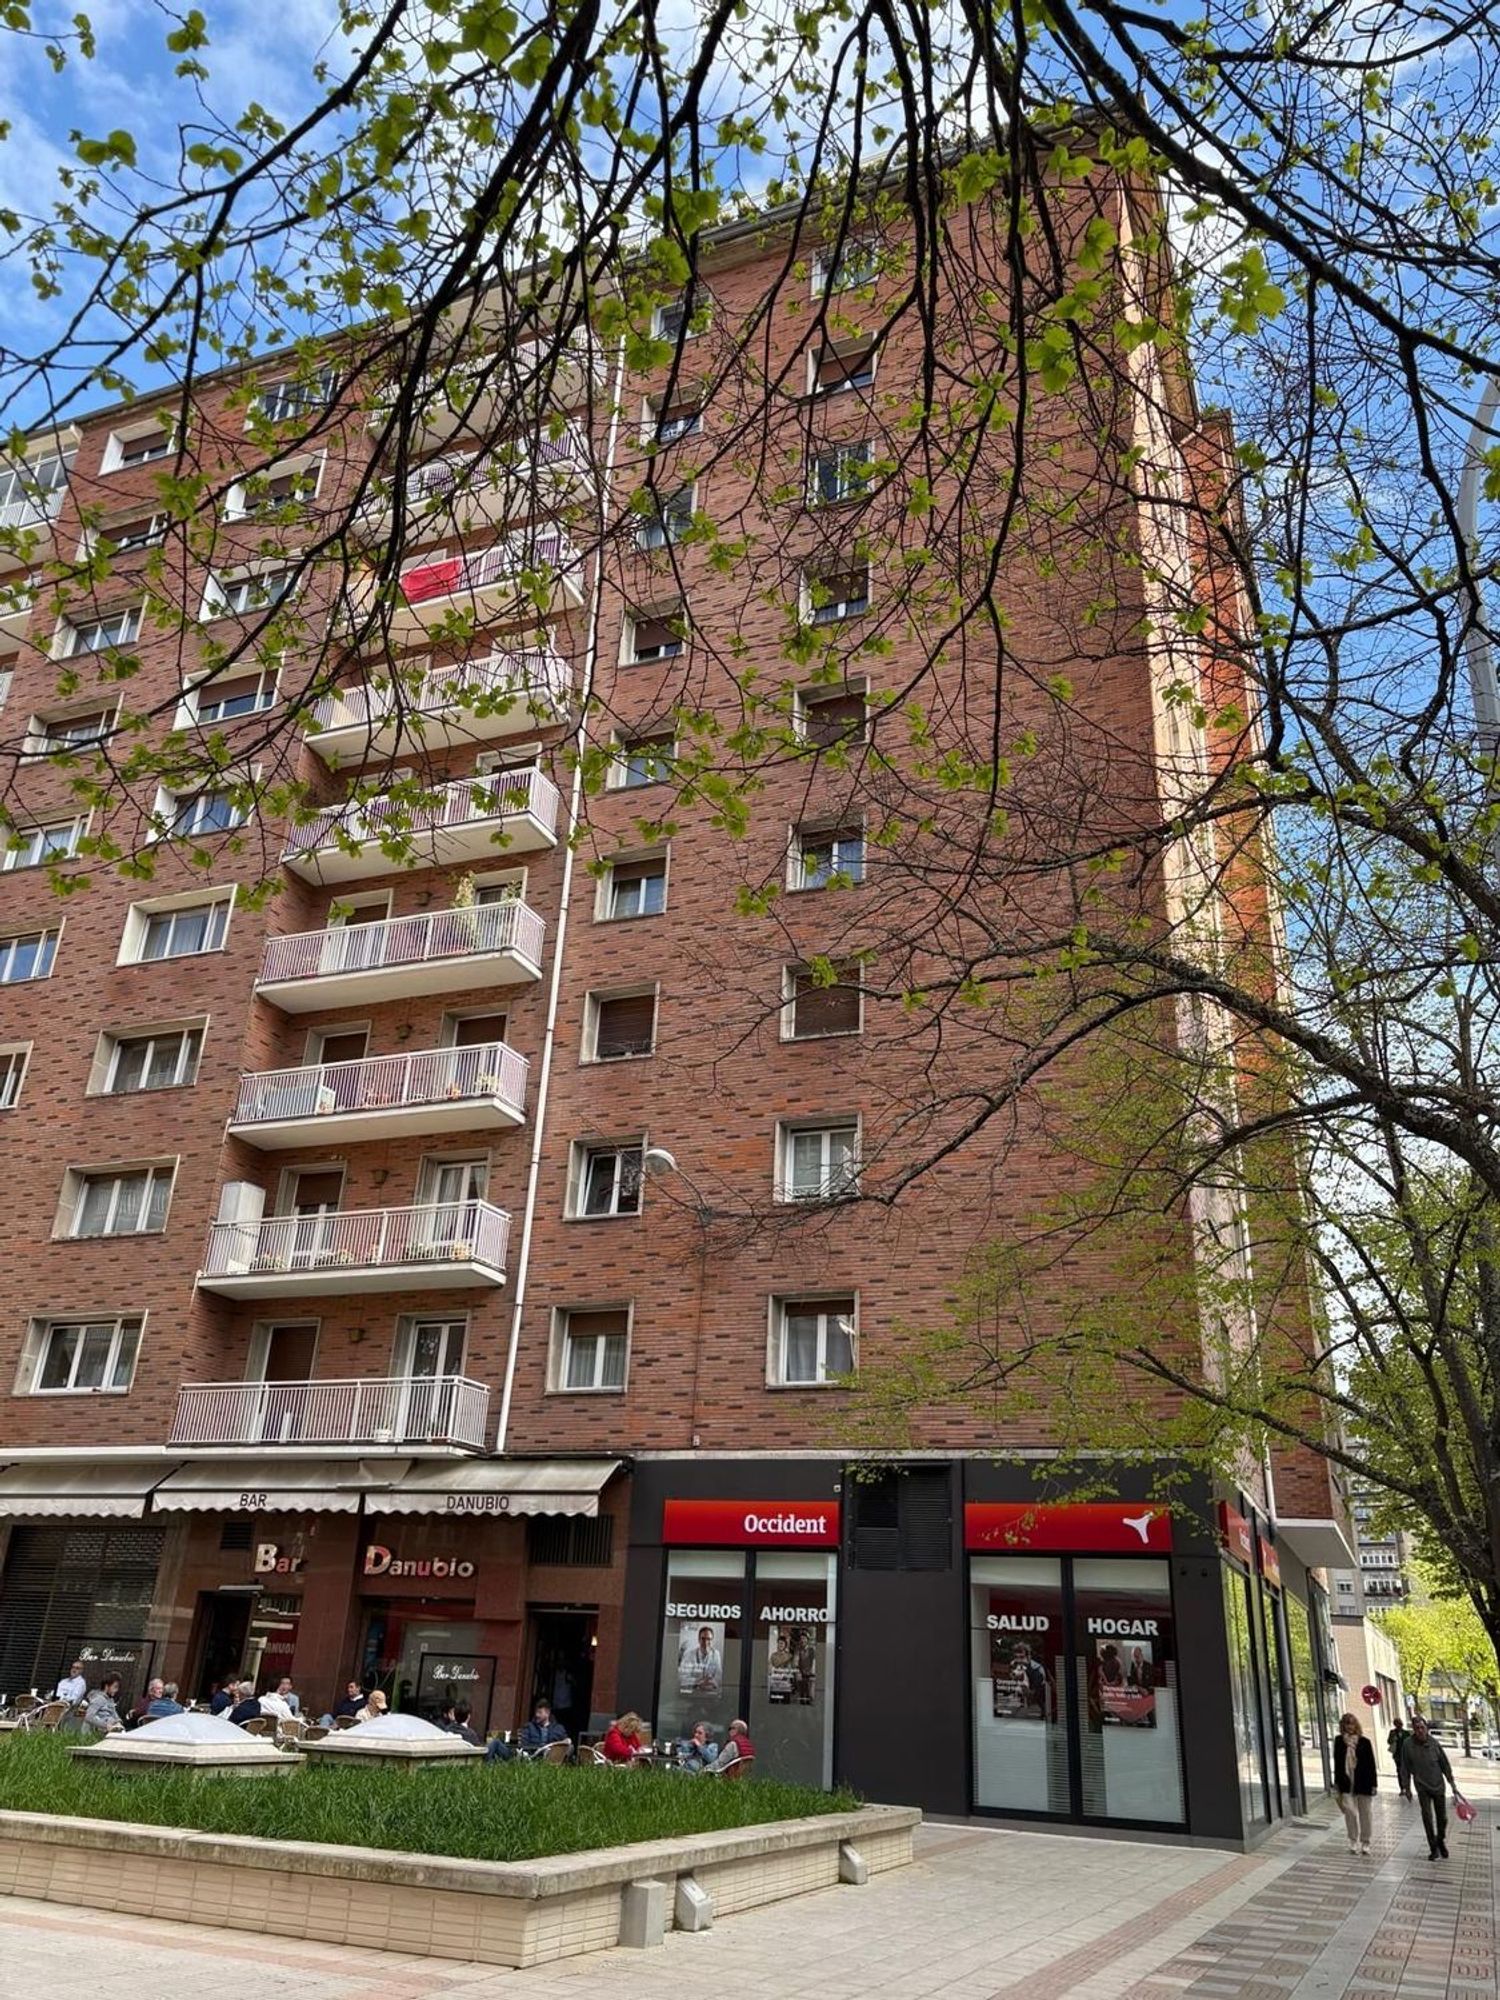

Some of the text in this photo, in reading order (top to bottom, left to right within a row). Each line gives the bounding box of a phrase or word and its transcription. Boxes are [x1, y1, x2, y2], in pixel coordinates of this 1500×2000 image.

[240, 1493, 510, 1511] BAR DANUBIO
[743, 1514, 827, 1535] Occident
[254, 1543, 475, 1577] Bar Danubio
[665, 1602, 742, 1619] SEGUROS
[759, 1606, 829, 1623] AHORRO
[986, 1614, 1050, 1633] SALUD
[1087, 1617, 1159, 1637] HOGAR
[79, 1647, 136, 1662] Bar Danubio
[432, 1664, 449, 1680] Bar
